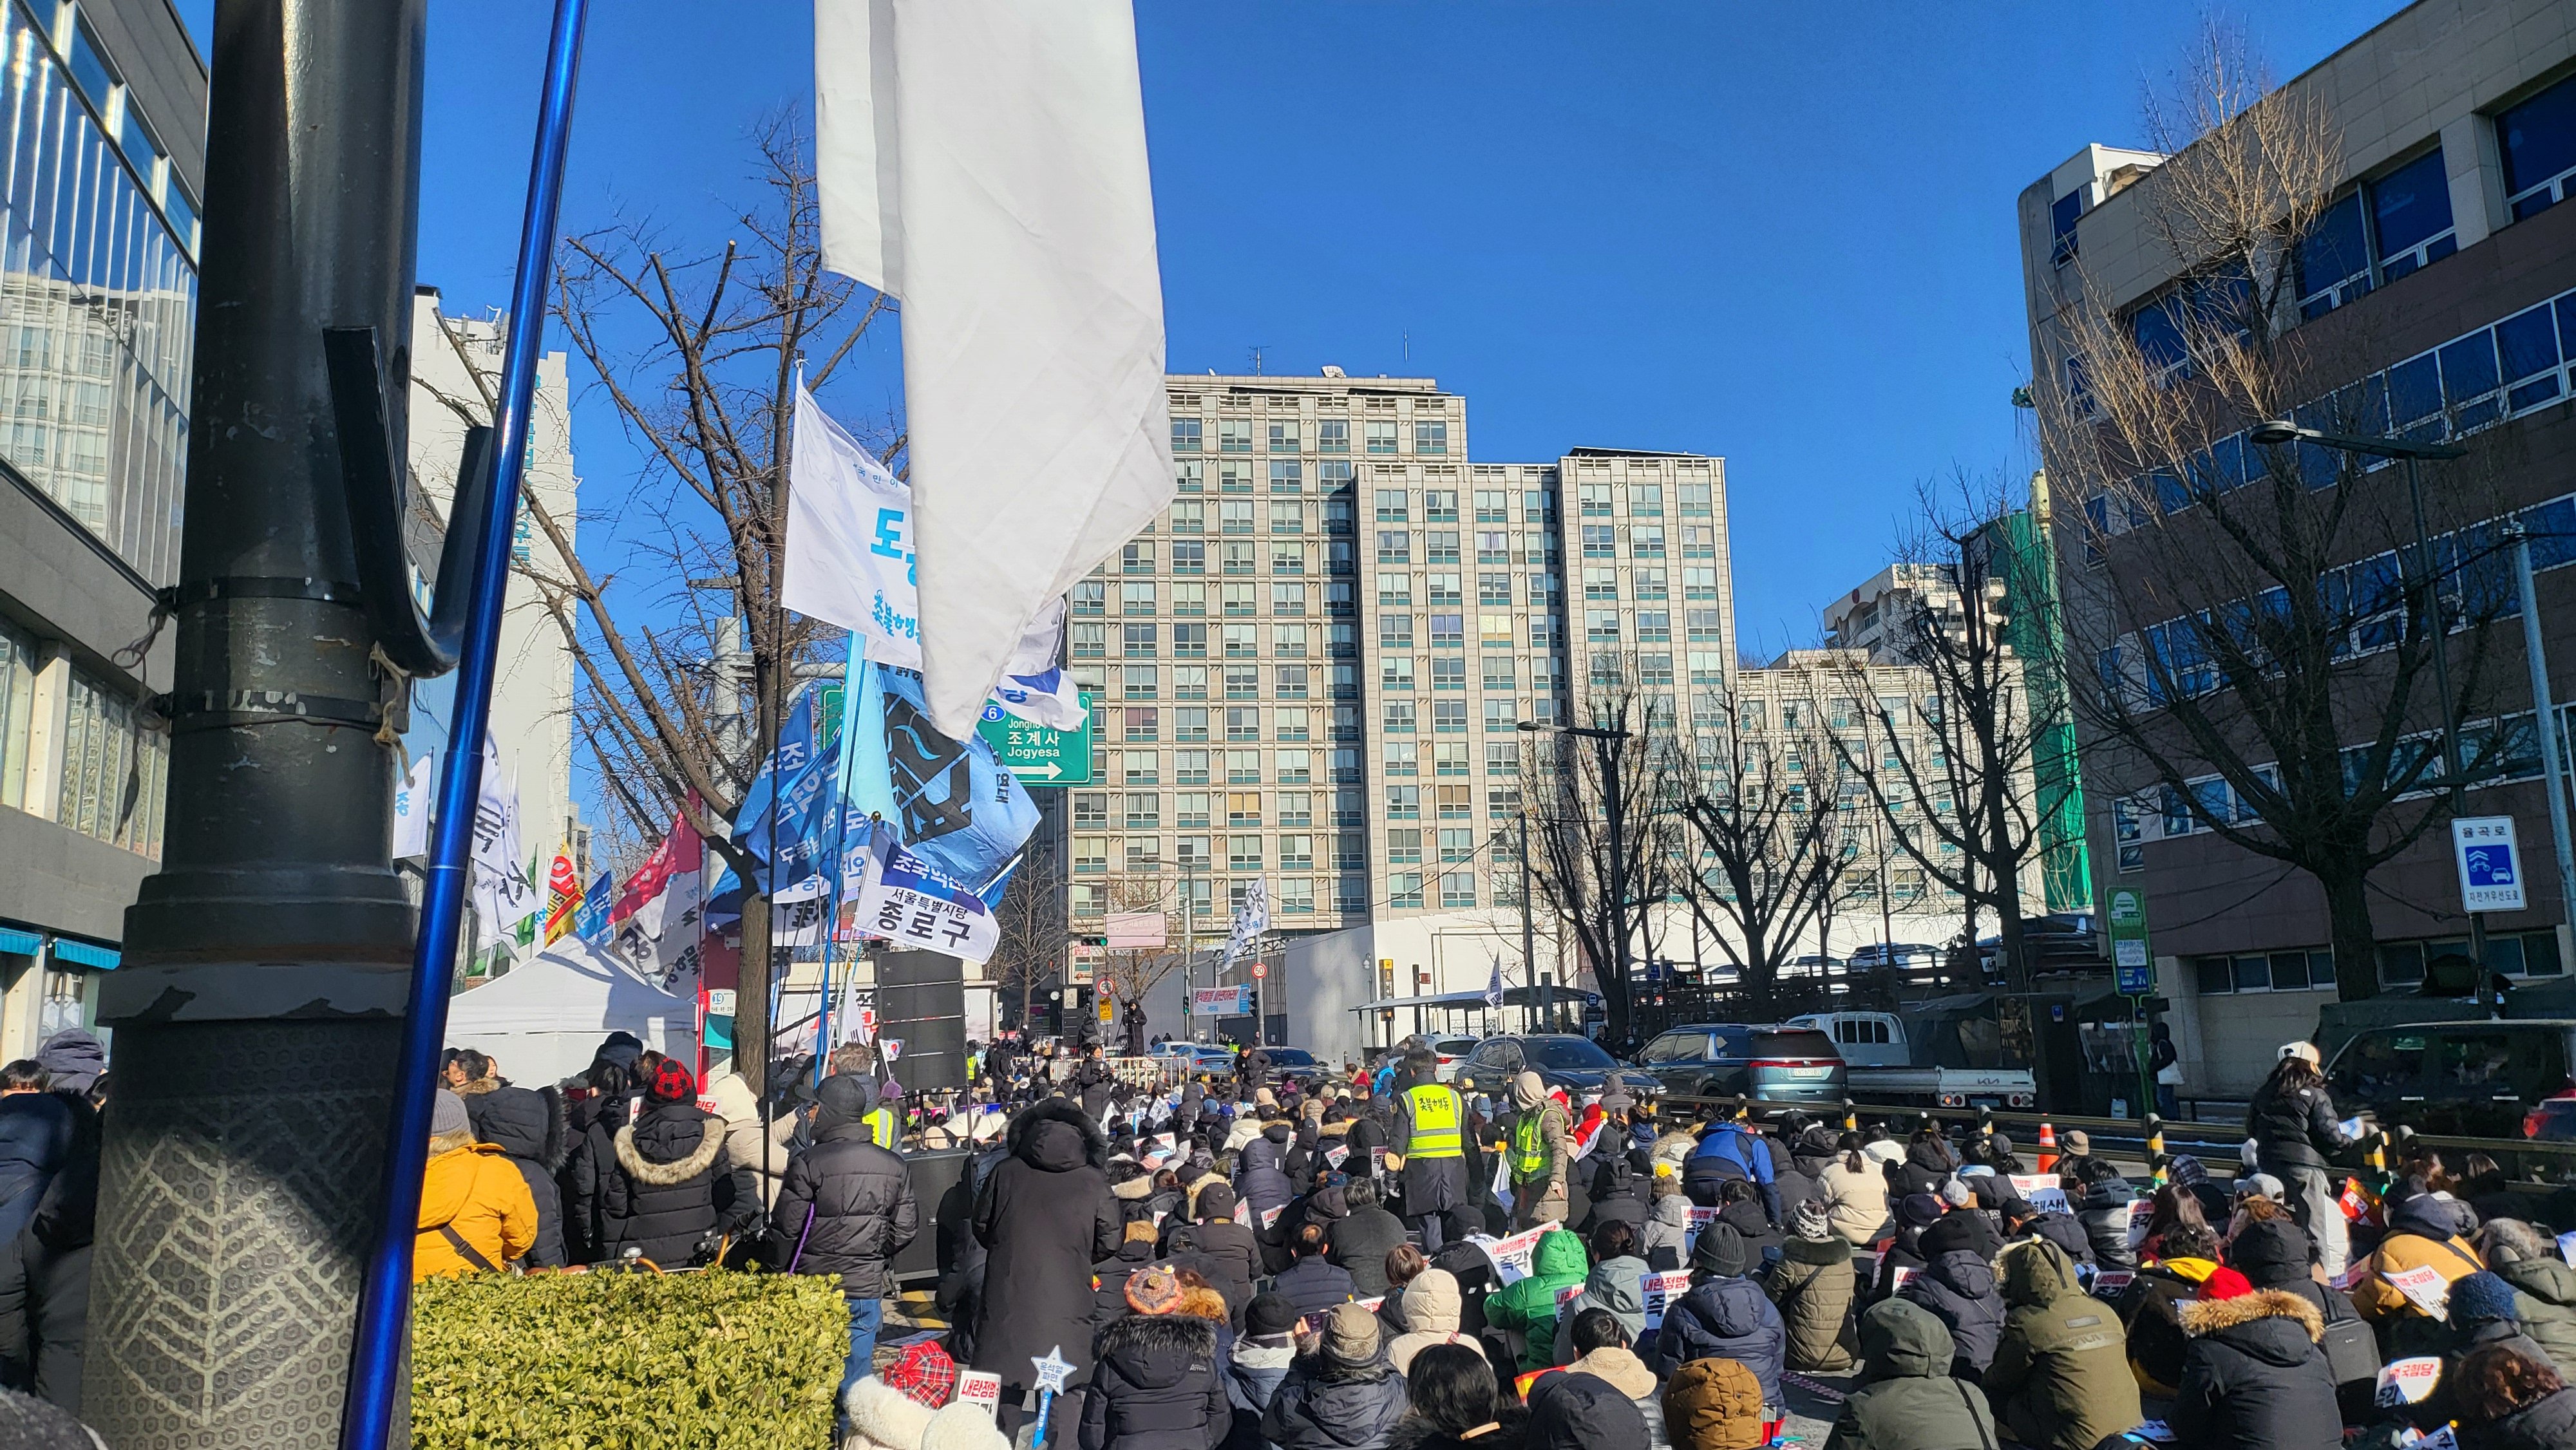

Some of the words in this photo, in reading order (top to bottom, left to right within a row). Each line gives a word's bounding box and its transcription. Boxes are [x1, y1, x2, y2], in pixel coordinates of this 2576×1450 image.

[988, 708, 998, 720] 6
[1007, 731, 1060, 747] 조계사
[1007, 746, 1061, 759] Jogyesa
[2462, 826, 2507, 838] 율곡로
[891, 888, 968, 920] 서울특별시당
[2468, 890, 2519, 901] 자전거우선도로
[878, 899, 971, 948] 종로구
[1101, 983, 1112, 992] 50
[714, 994, 723, 1004] 19
[1418, 1094, 1450, 1113] 촛불행동
[1492, 1236, 1526, 1255] 내란정범
[1499, 1250, 1530, 1272] 즉각
[1643, 1275, 1687, 1293] 내란정범
[961, 1379, 997, 1399] 내란정범
